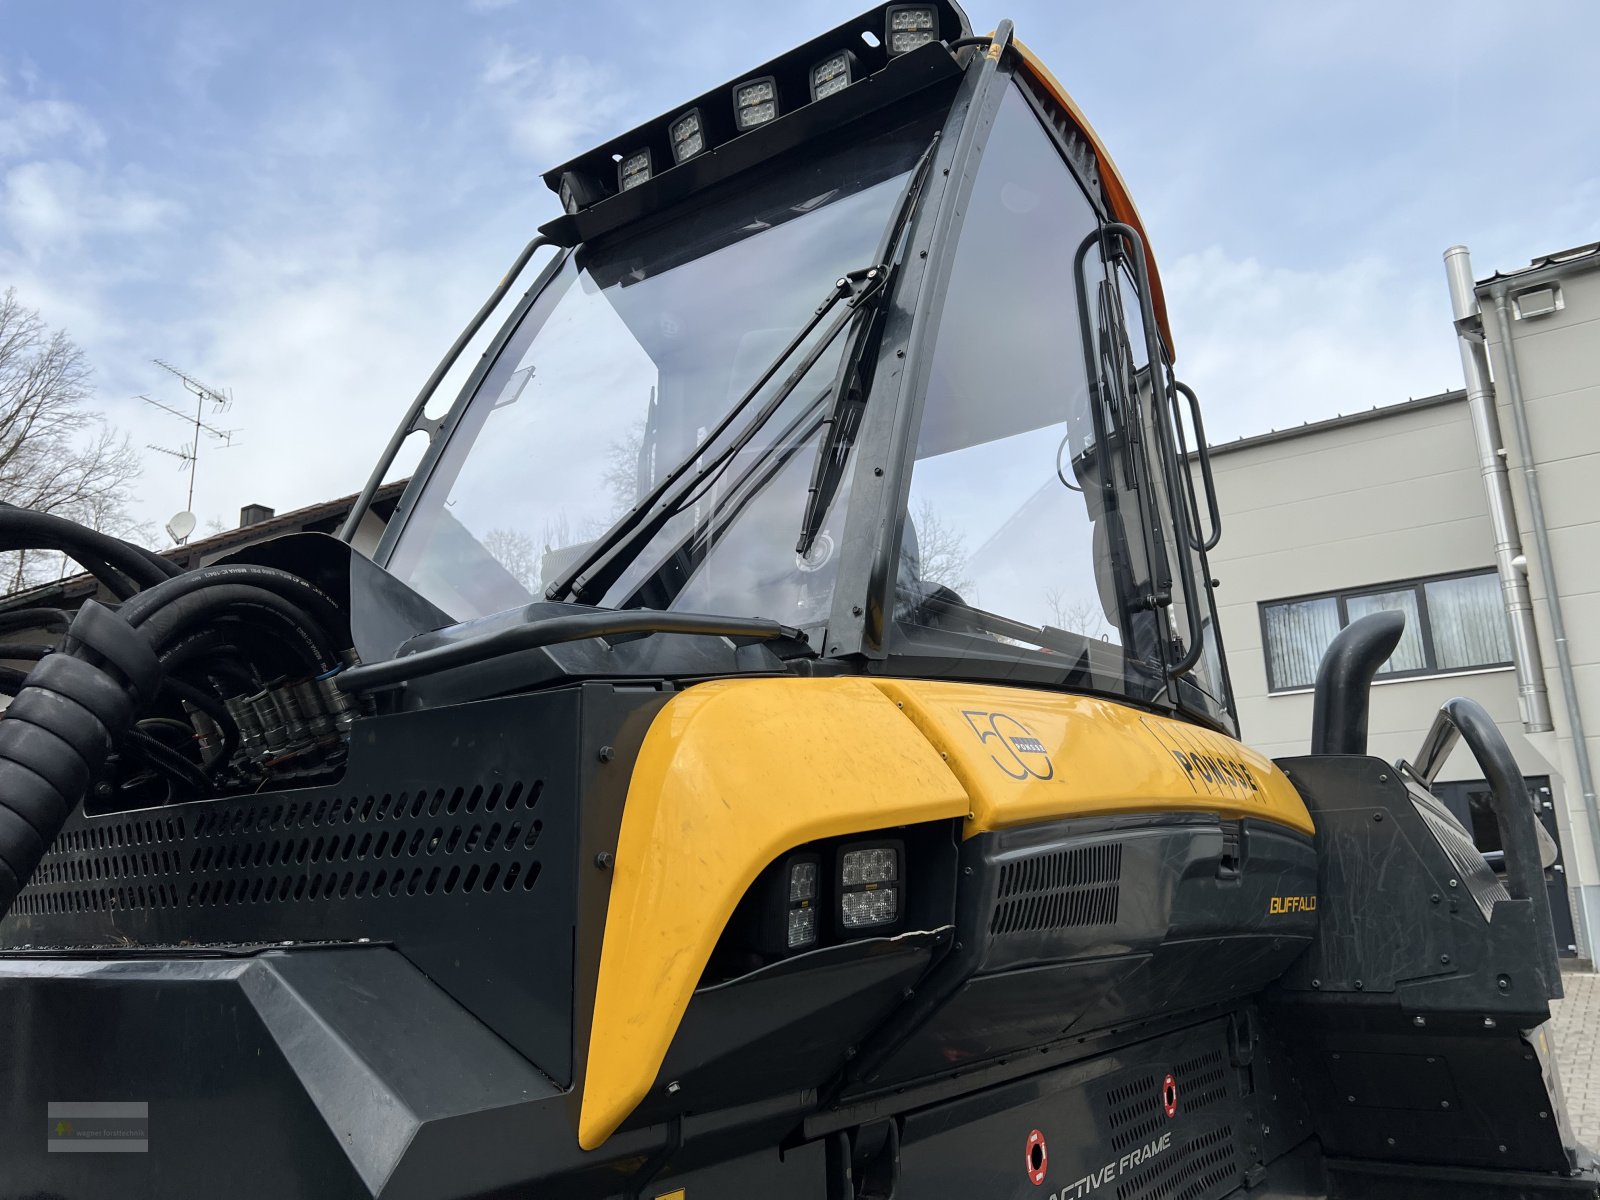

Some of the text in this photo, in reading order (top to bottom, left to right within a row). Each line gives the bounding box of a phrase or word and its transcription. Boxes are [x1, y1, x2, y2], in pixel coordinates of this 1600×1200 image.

[961, 710, 1053, 780] 50
[1015, 743, 1047, 752] PONSSE
[1172, 750, 1258, 791] PONSSE
[1270, 896, 1316, 914] BUFFALO
[1120, 1132, 1171, 1175] FRAME
